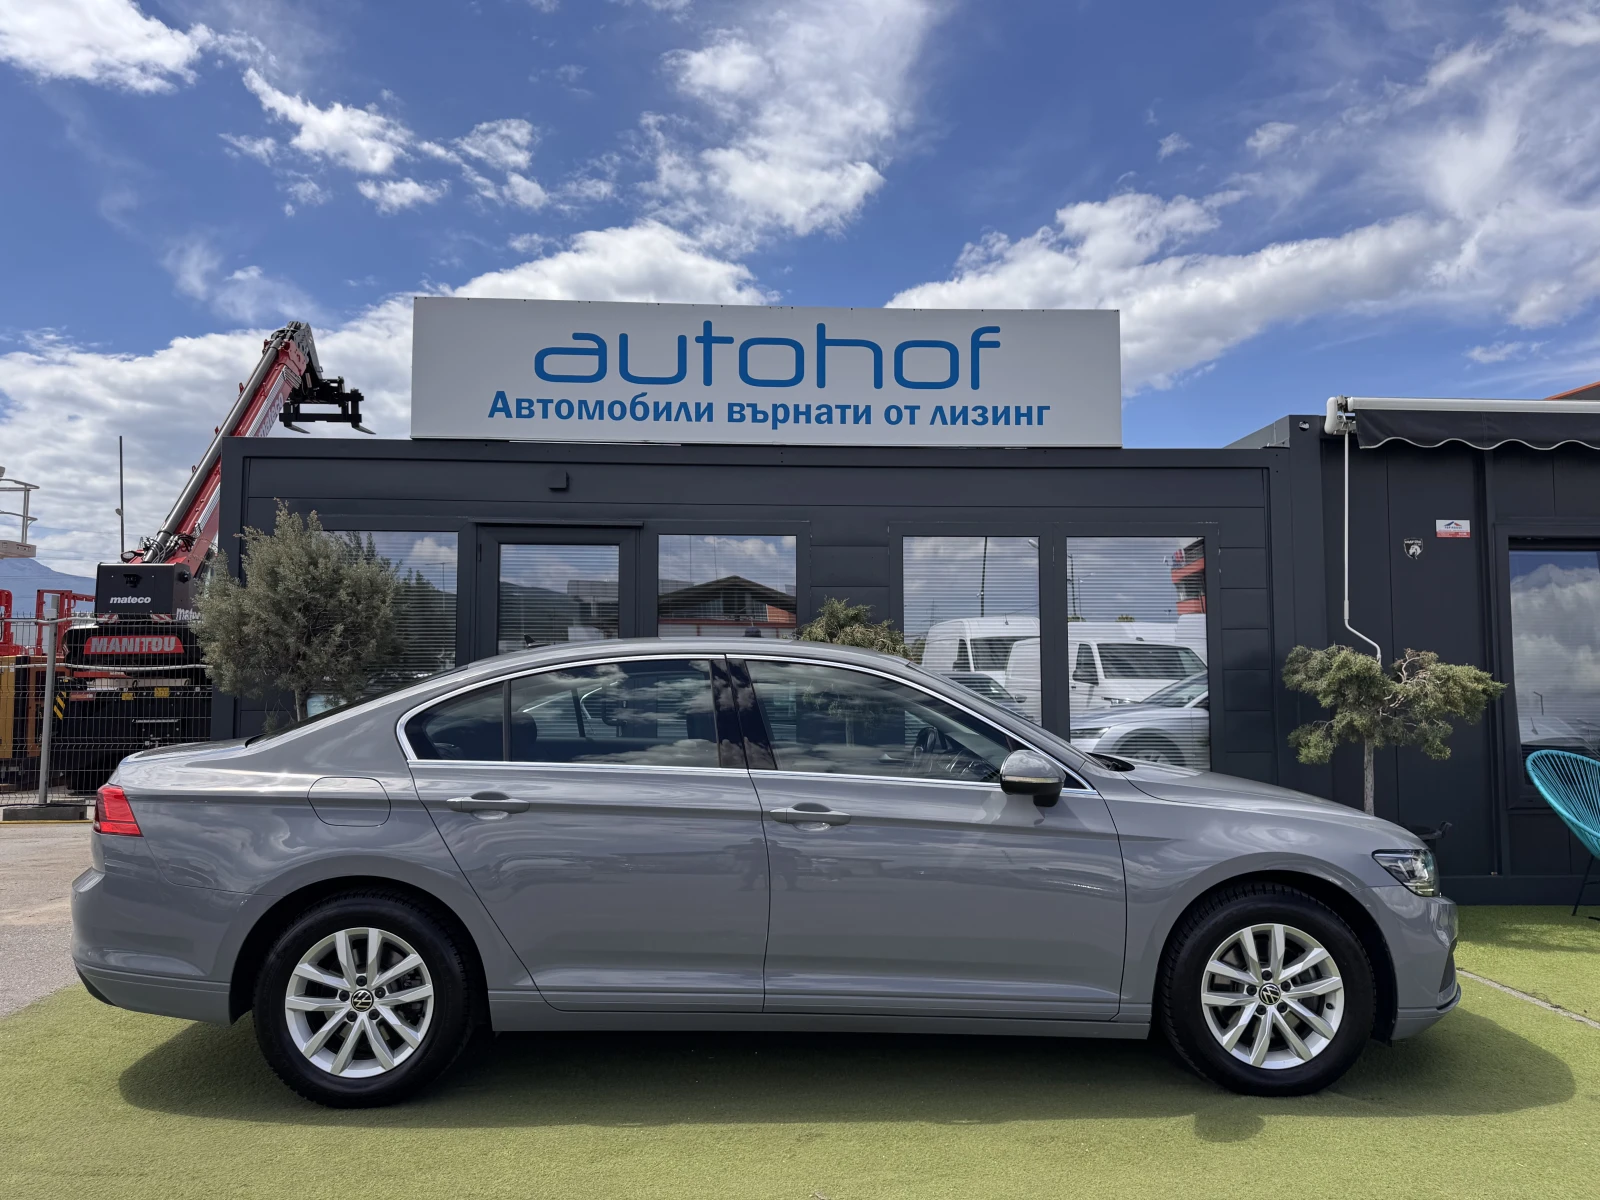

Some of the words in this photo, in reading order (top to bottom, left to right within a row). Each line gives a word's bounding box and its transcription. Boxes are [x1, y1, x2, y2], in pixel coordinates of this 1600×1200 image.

[534, 320, 1001, 391] autohof
[488, 391, 715, 423] Автомобили
[728, 402, 873, 431] върнати
[884, 405, 921, 426] от
[930, 405, 1051, 427] лизинг
[110, 596, 151, 604] mateco
[91, 637, 176, 653] MANITOU
